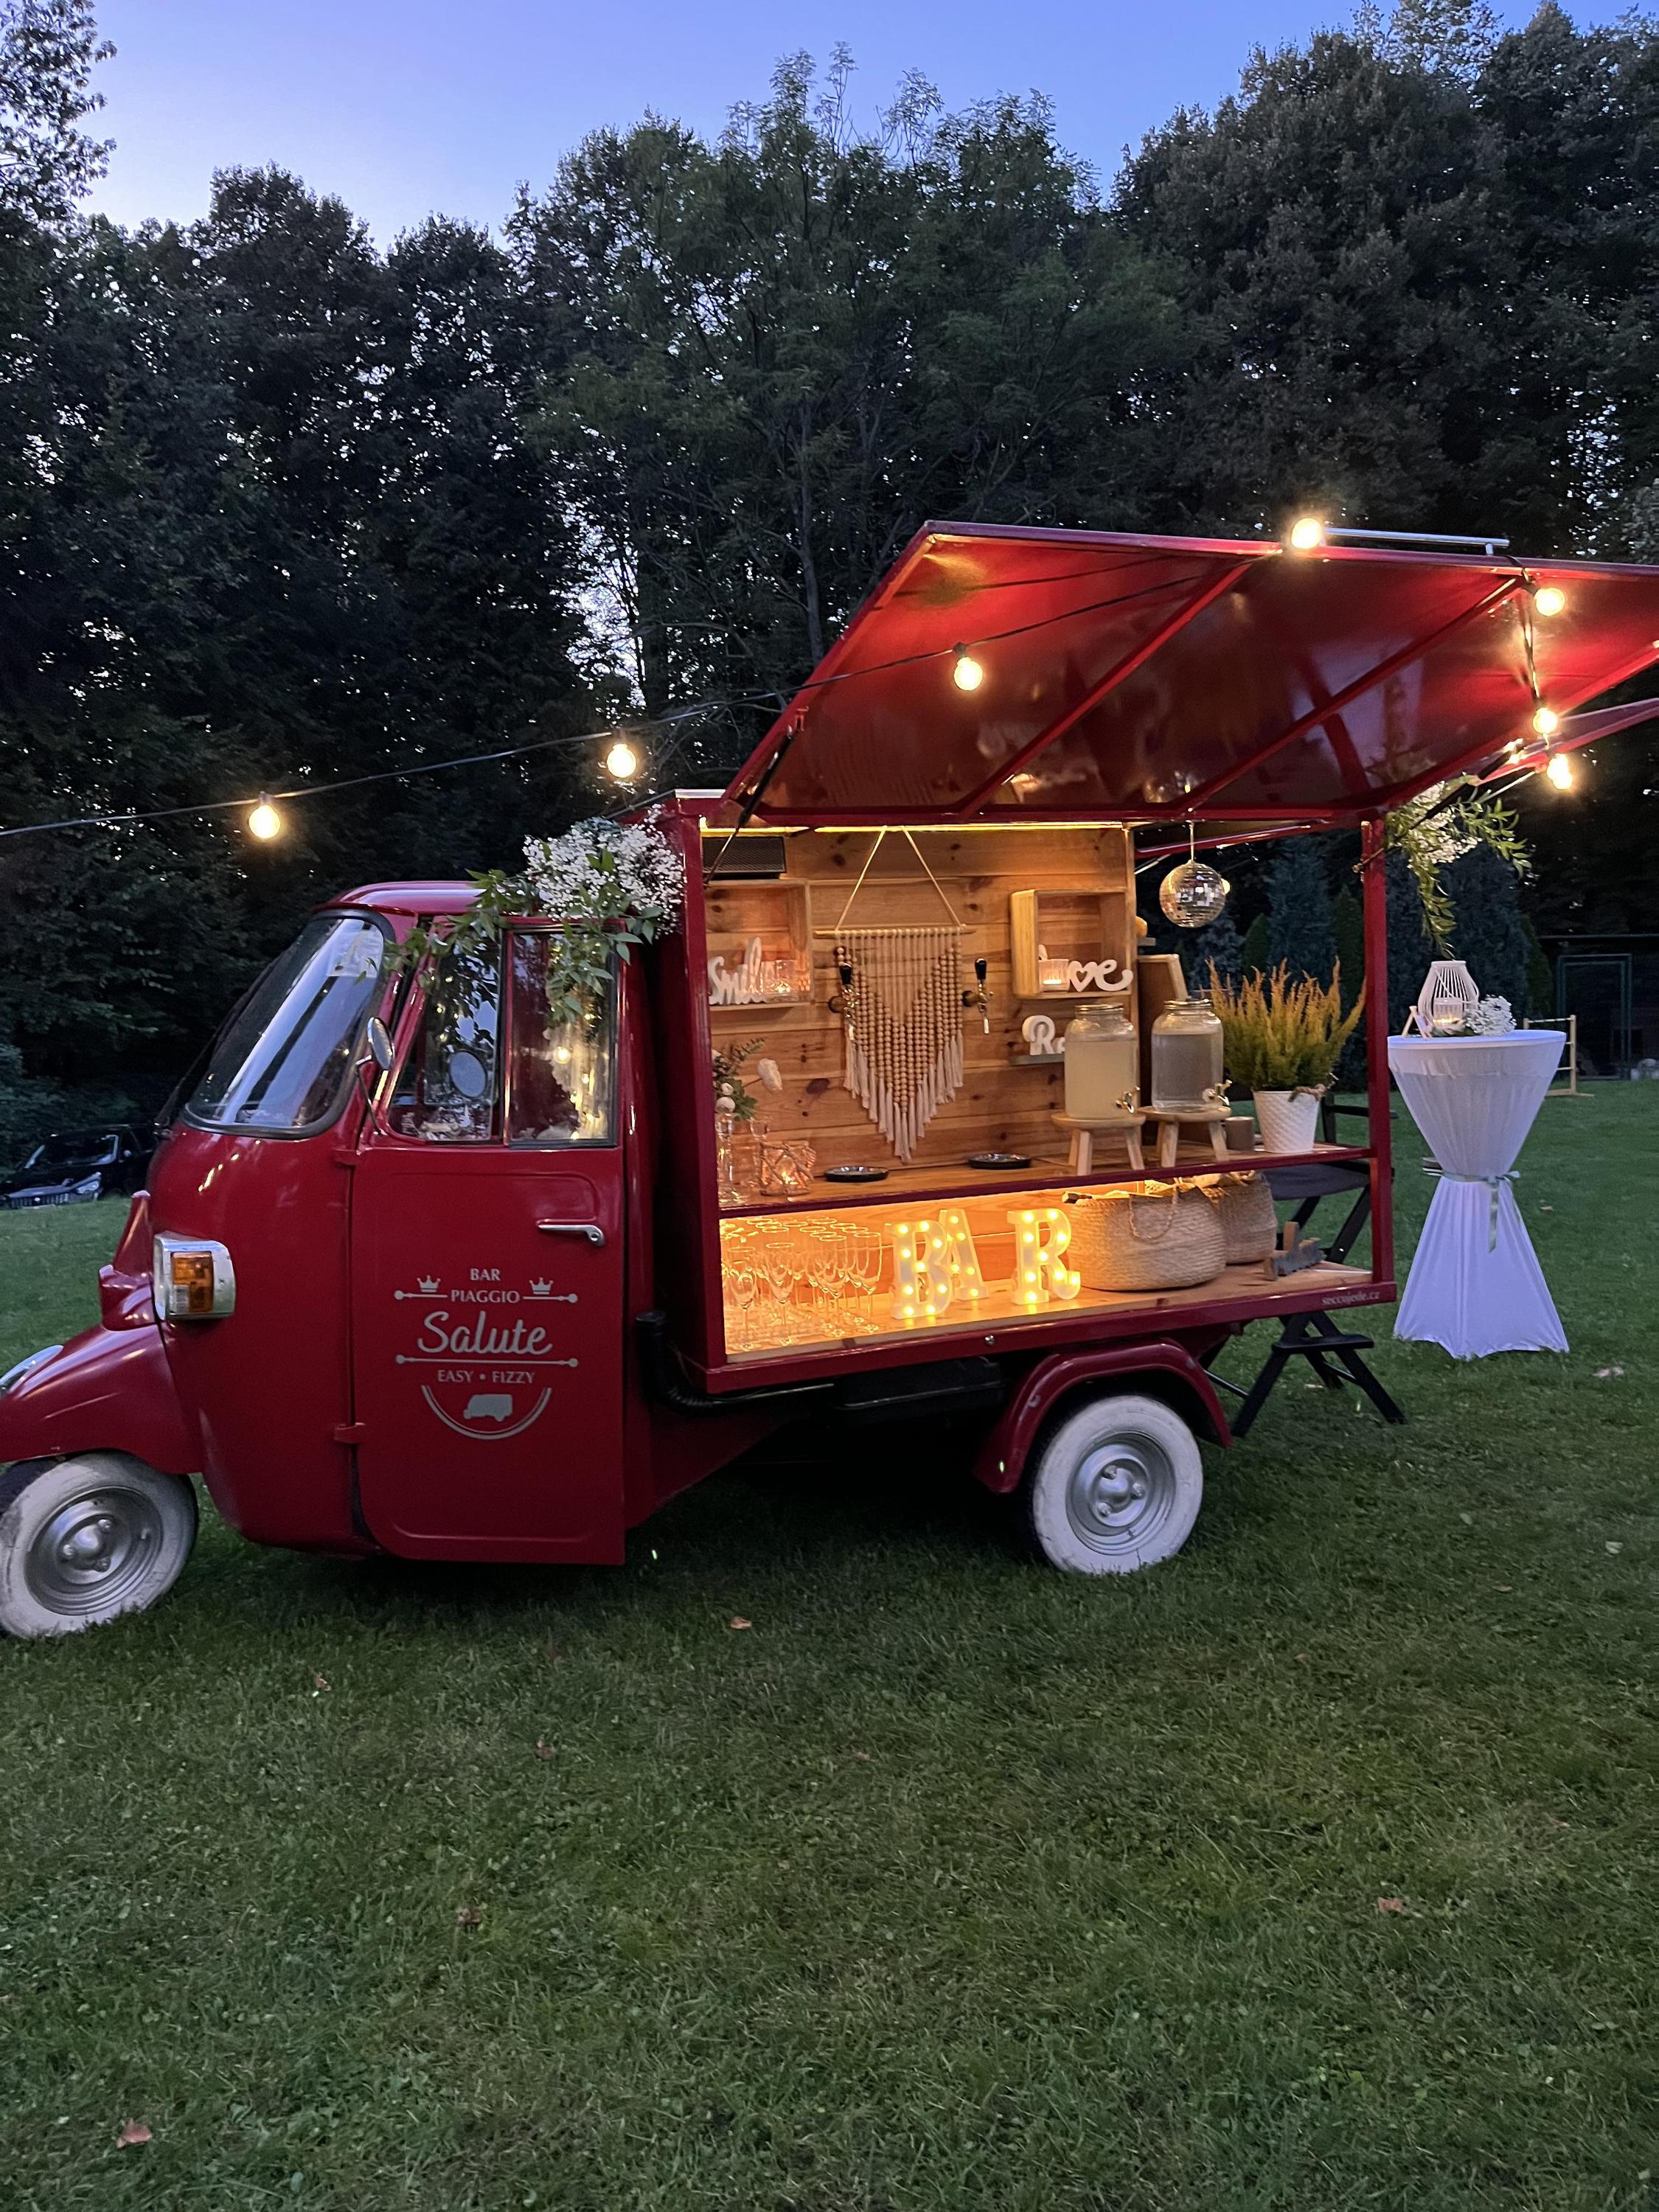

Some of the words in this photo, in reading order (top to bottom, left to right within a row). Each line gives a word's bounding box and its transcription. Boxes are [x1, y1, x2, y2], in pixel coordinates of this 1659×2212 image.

[885, 1208, 1081, 1320] BAR
[470, 1267, 501, 1281] BAR
[450, 1289, 521, 1304] PIAGGIO
[417, 1310, 553, 1355] Salute
[437, 1369, 474, 1383] EASY
[491, 1371, 535, 1384] FIZZY
